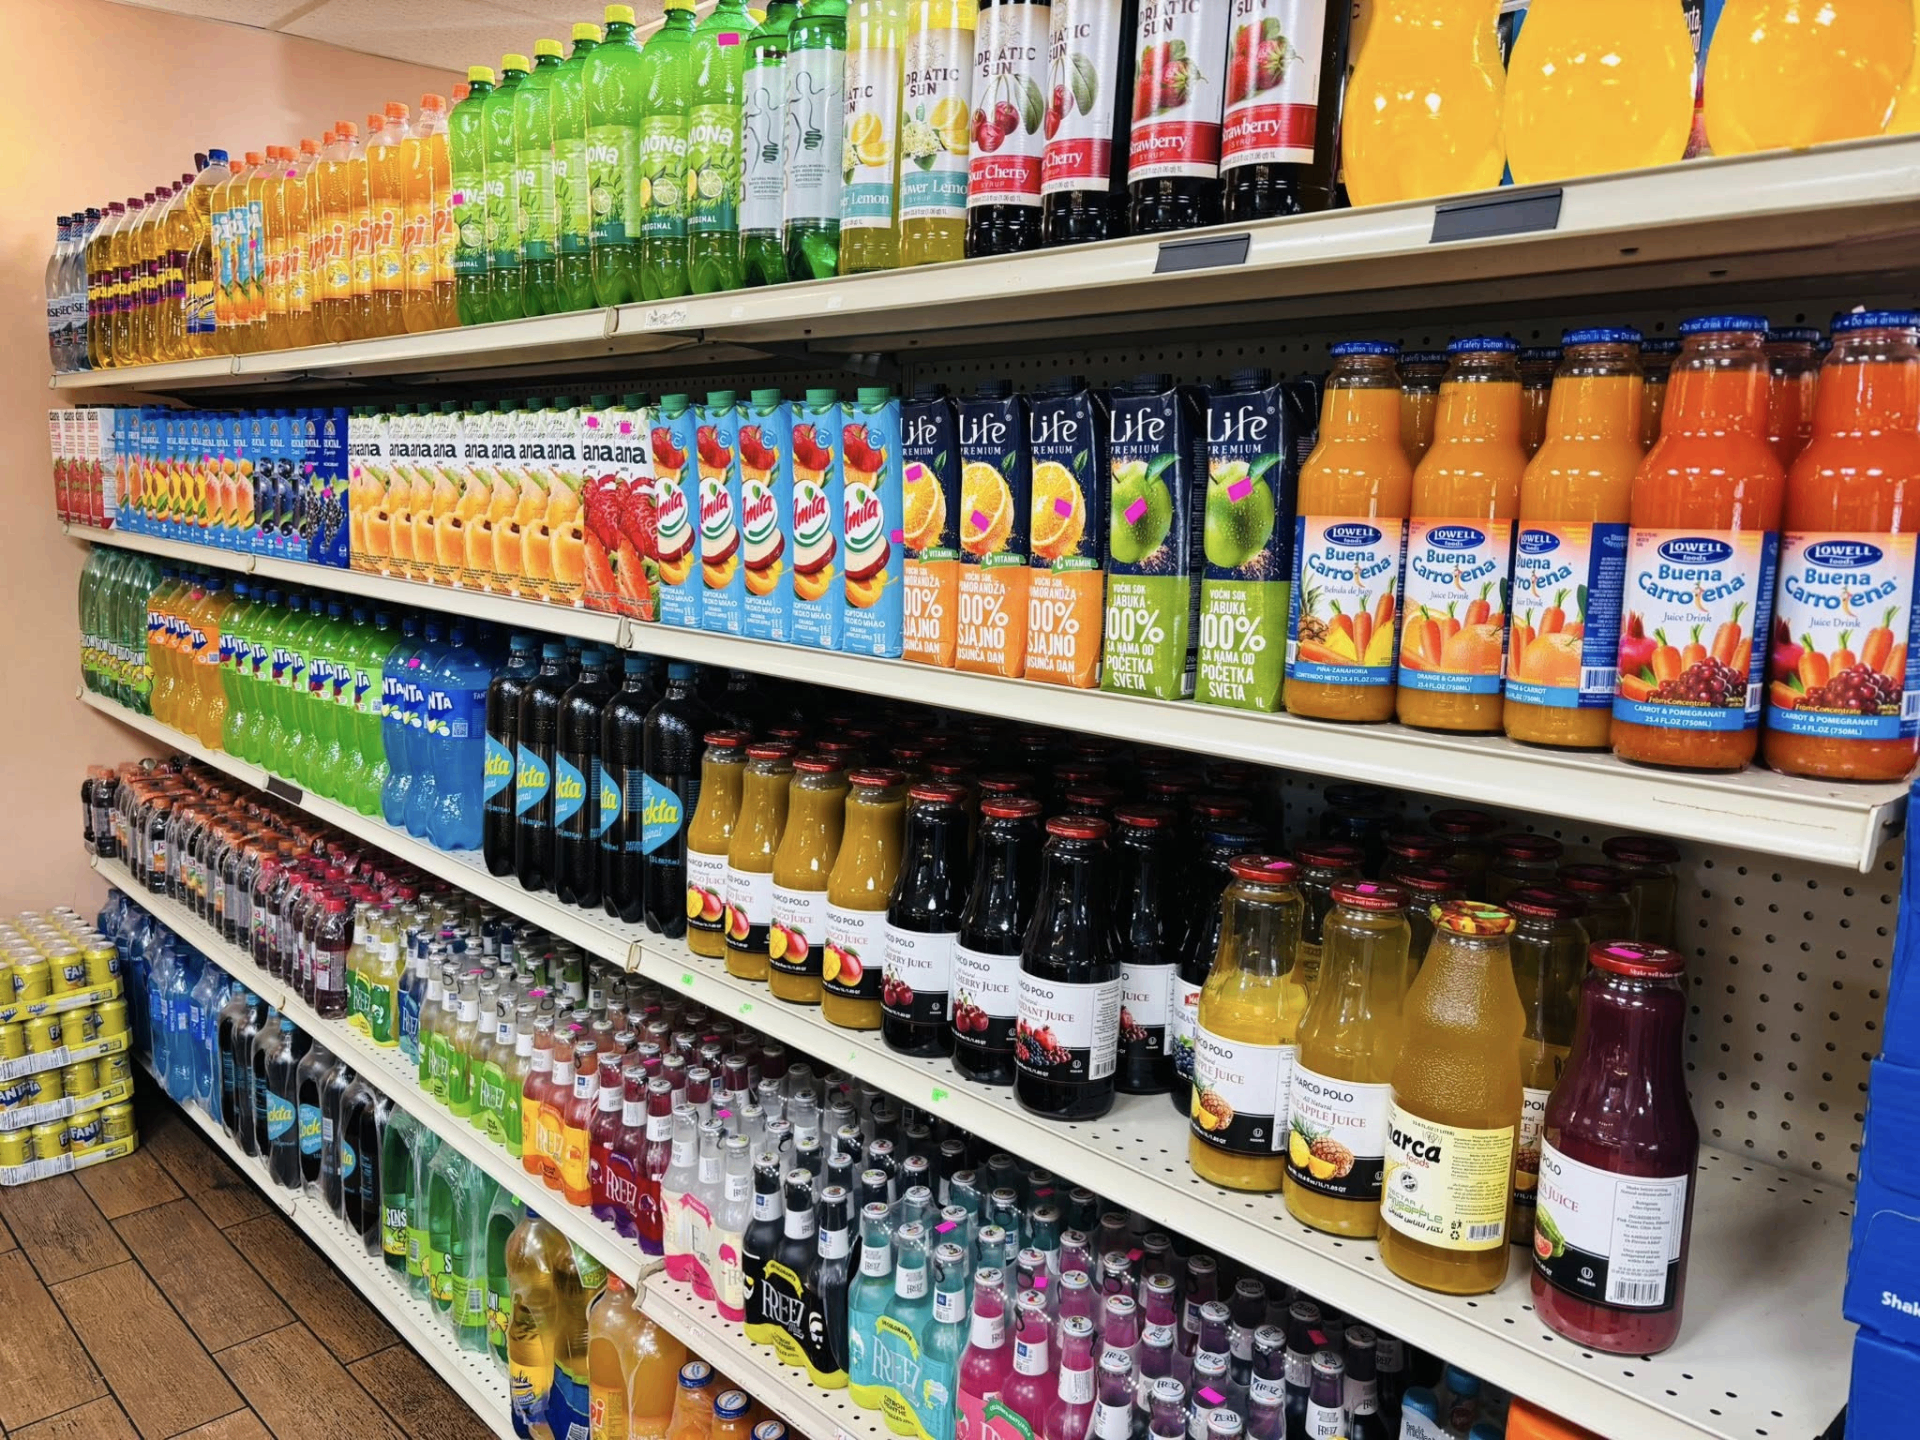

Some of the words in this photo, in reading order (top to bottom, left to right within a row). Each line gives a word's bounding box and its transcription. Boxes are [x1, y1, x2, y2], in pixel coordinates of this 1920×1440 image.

[1143, 17, 1174, 38] SUN
[982, 63, 1016, 78] SUN
[909, 81, 938, 98] SUN
[1046, 149, 1084, 169] Cherry
[985, 164, 1030, 185] Cherry
[850, 191, 890, 206] Lemon
[959, 412, 1006, 444] Life
[1030, 410, 1078, 444] Life
[1110, 406, 1166, 443] Life
[1207, 404, 1268, 443] Life
[583, 444, 615, 463] ana
[615, 445, 648, 465] ana
[1333, 526, 1374, 538] LOWELL
[1434, 529, 1477, 540] LOWELL
[928, 549, 953, 559] VITAMIN
[1325, 547, 1375, 562] Buena
[1669, 541, 1724, 554] LOWELL
[1815, 544, 1873, 557] LOWELL
[994, 555, 1020, 564] VITAMIN
[1065, 558, 1092, 568] VITAMIN
[1427, 549, 1476, 564] Buena
[1682, 553, 1707, 562] foods
[1829, 557, 1854, 566] foods
[1658, 563, 1722, 582] Buena
[1804, 567, 1871, 586] Buena
[1112, 594, 1145, 608] JABUKA
[1232, 590, 1247, 601] SOK
[1430, 590, 1447, 601] Juice
[1447, 590, 1469, 600] Drink
[1209, 600, 1246, 615] JABUKA
[1106, 606, 1165, 643] 100%
[1662, 612, 1685, 624] Juice
[1686, 612, 1713, 623] Drink
[1809, 617, 1832, 629] Juice
[1833, 617, 1861, 628] Drink
[957, 624, 1005, 649] SJAJNO
[1200, 613, 1267, 652] 100%
[1027, 630, 1076, 658] SJAJNO
[1106, 653, 1153, 674] POČETKA
[1201, 648, 1212, 660] SA
[1213, 650, 1239, 664] NAMA
[1242, 652, 1255, 665] OD
[1056, 659, 1075, 672] DAN
[1201, 661, 1255, 684] POČETKA
[1112, 673, 1147, 691] SVETA
[1417, 673, 1441, 682] ORANGE
[1448, 675, 1473, 683] CARROT
[1209, 682, 1246, 701] SVETA
[1523, 686, 1547, 695] CARROT
[1634, 704, 1660, 714] CARROT
[1662, 707, 1668, 715] &
[1669, 708, 1727, 718] POMEGRANATE
[1645, 715, 1662, 724] 25.4
[1682, 718, 1712, 728] (750ML)
[1781, 711, 1807, 722] CARROT
[1809, 715, 1815, 723] &
[1816, 716, 1879, 727] POMEGRANATE
[1792, 723, 1807, 732] 25.4
[1830, 726, 1862, 736] (750ML)
[703, 861, 723, 870] POLO
[789, 897, 810, 907] POLO
[790, 914, 814, 924] JUICE
[842, 918, 864, 928] POLO
[844, 934, 869, 946] JUICE
[895, 937, 915, 949] POLO
[906, 957, 933, 969] JUICE
[968, 960, 990, 972] POLO
[982, 981, 1010, 993] JUICE
[1031, 986, 1054, 1000] POLO
[1121, 990, 1150, 1002] JUICE
[1045, 1007, 1075, 1022] JUICE
[1208, 1045, 1233, 1060] POLO
[1213, 1066, 1245, 1085] JUICE
[1294, 1075, 1321, 1094] MARCO
[1322, 1087, 1354, 1103] POLO
[1331, 1113, 1367, 1128] JUICE
[1406, 1152, 1430, 1169] foods
[1541, 1154, 1562, 1176] POLO
[1548, 1186, 1579, 1213] JUICE
